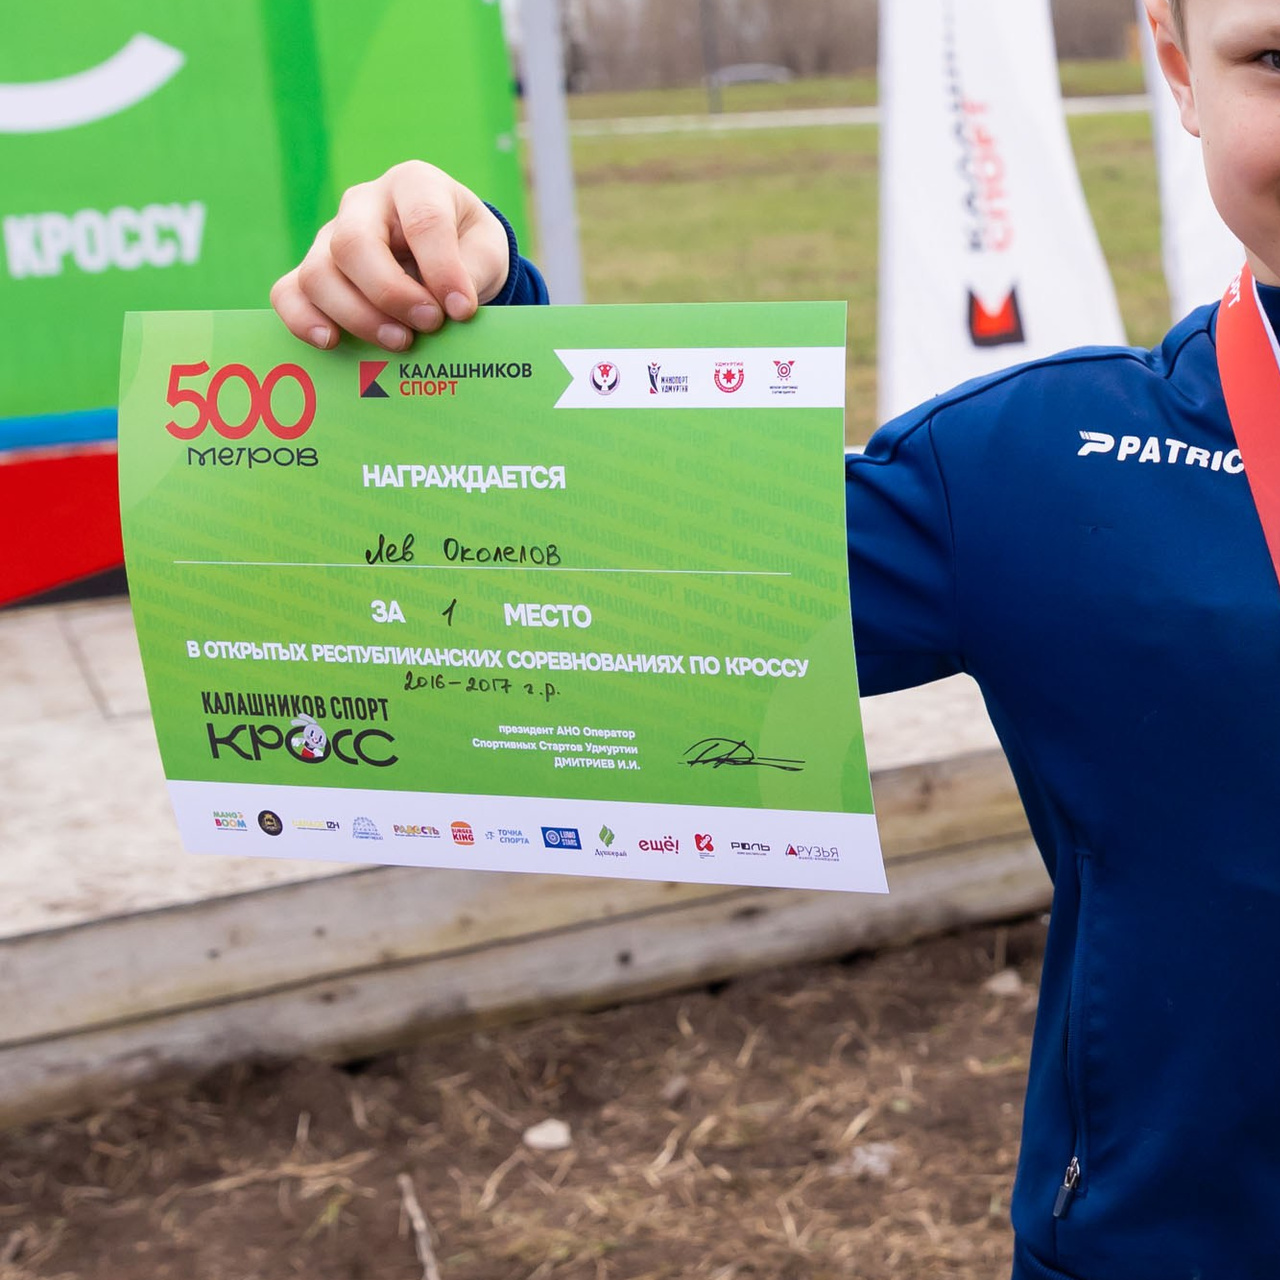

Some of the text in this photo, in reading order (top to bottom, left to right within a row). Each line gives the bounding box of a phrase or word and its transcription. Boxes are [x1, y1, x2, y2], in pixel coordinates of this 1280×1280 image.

[3, 202, 206, 279] КРОССУ
[399, 363, 532, 379] КАЛАШНИКОВ
[399, 380, 458, 396] СПОРТ
[165, 361, 316, 440] 500
[1117, 435, 1245, 474] PATRIC
[362, 464, 567, 493] НАГРАЖДАЕТСЯ
[365, 534, 414, 564] Лев
[370, 599, 592, 629] ЗА 1 МЕСТО
[187, 640, 809, 678] В ОТКРЫТЫХ РЕСПУБЛИКАНСКИХ СОРЕВНОВАНИЯХ ПО КРОССУ
[201, 692, 389, 721] КАЛАШНИКОВ СПОРТ
[499, 725, 636, 740] президент АНО Оператор
[206, 722, 399, 767] КРОСС
[472, 738, 638, 755] Спортивных Стартов Удмуртии
[554, 757, 641, 770] ДМИТРИЕВ И.И.
[214, 818, 248, 829] BOOM
[498, 829, 523, 837] ТОЧКА
[453, 833, 475, 842] KING
[500, 836, 530, 845] СПОРТА
[638, 835, 680, 854] ещё!
